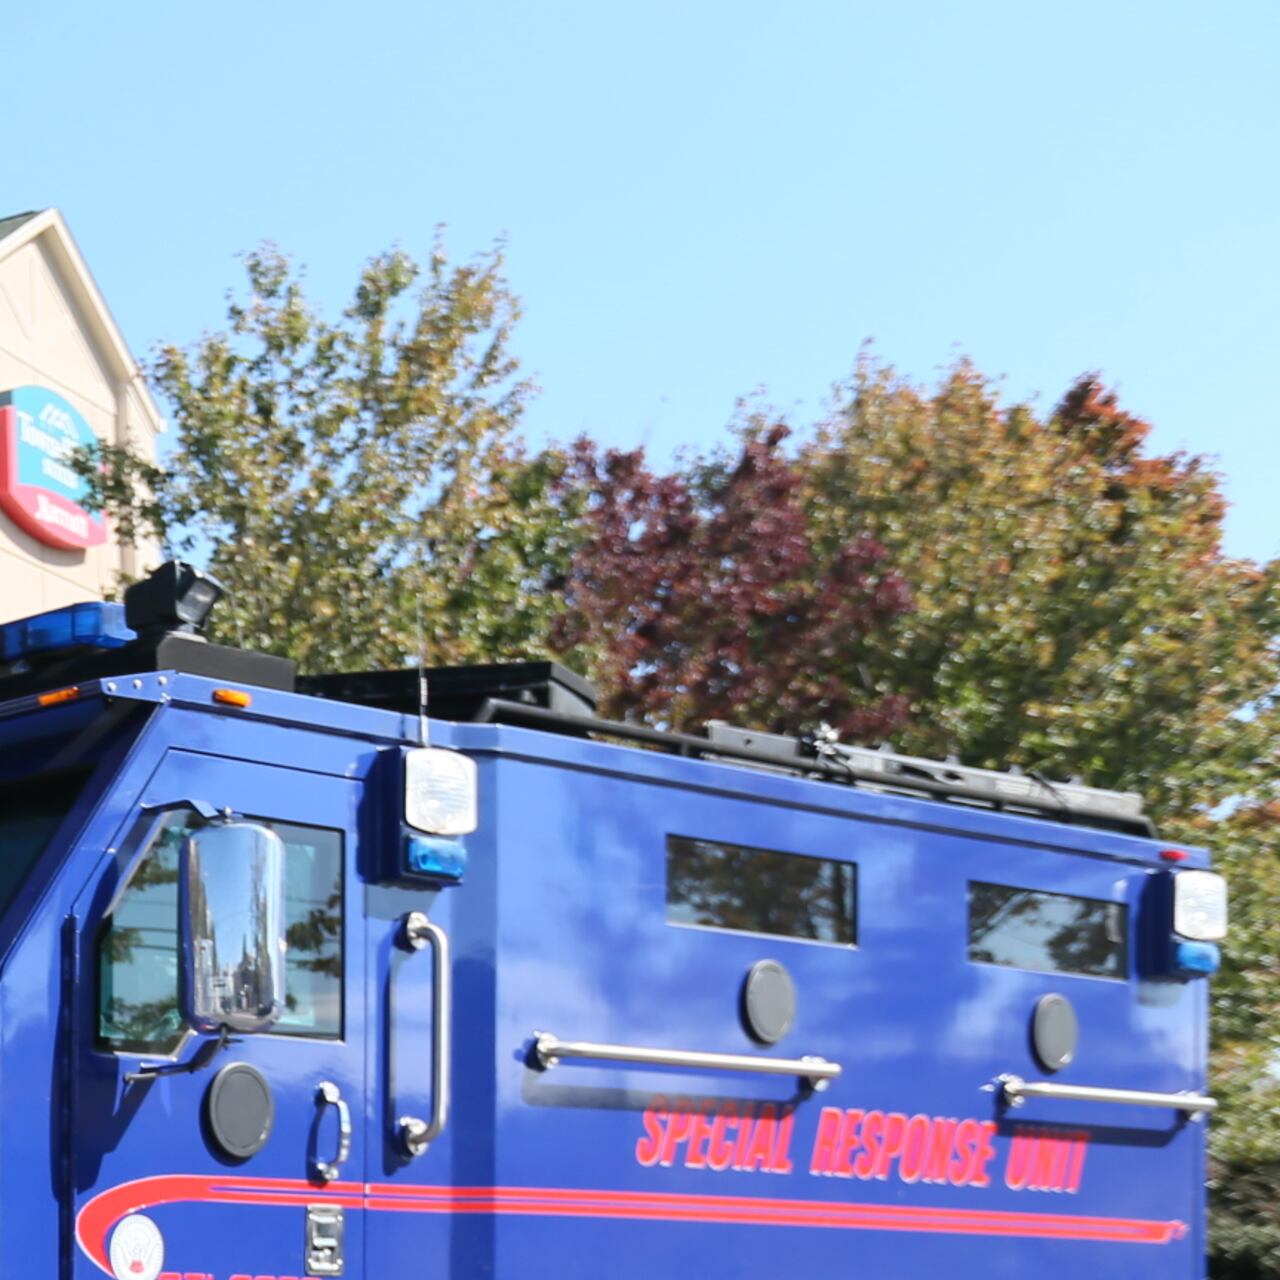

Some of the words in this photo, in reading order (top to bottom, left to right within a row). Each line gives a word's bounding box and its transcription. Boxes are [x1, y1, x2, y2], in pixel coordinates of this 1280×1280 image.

[635, 1094, 794, 1174] SPECIAL
[809, 1106, 999, 1188] RESPONSE
[1005, 1124, 1090, 1194] UNIT
